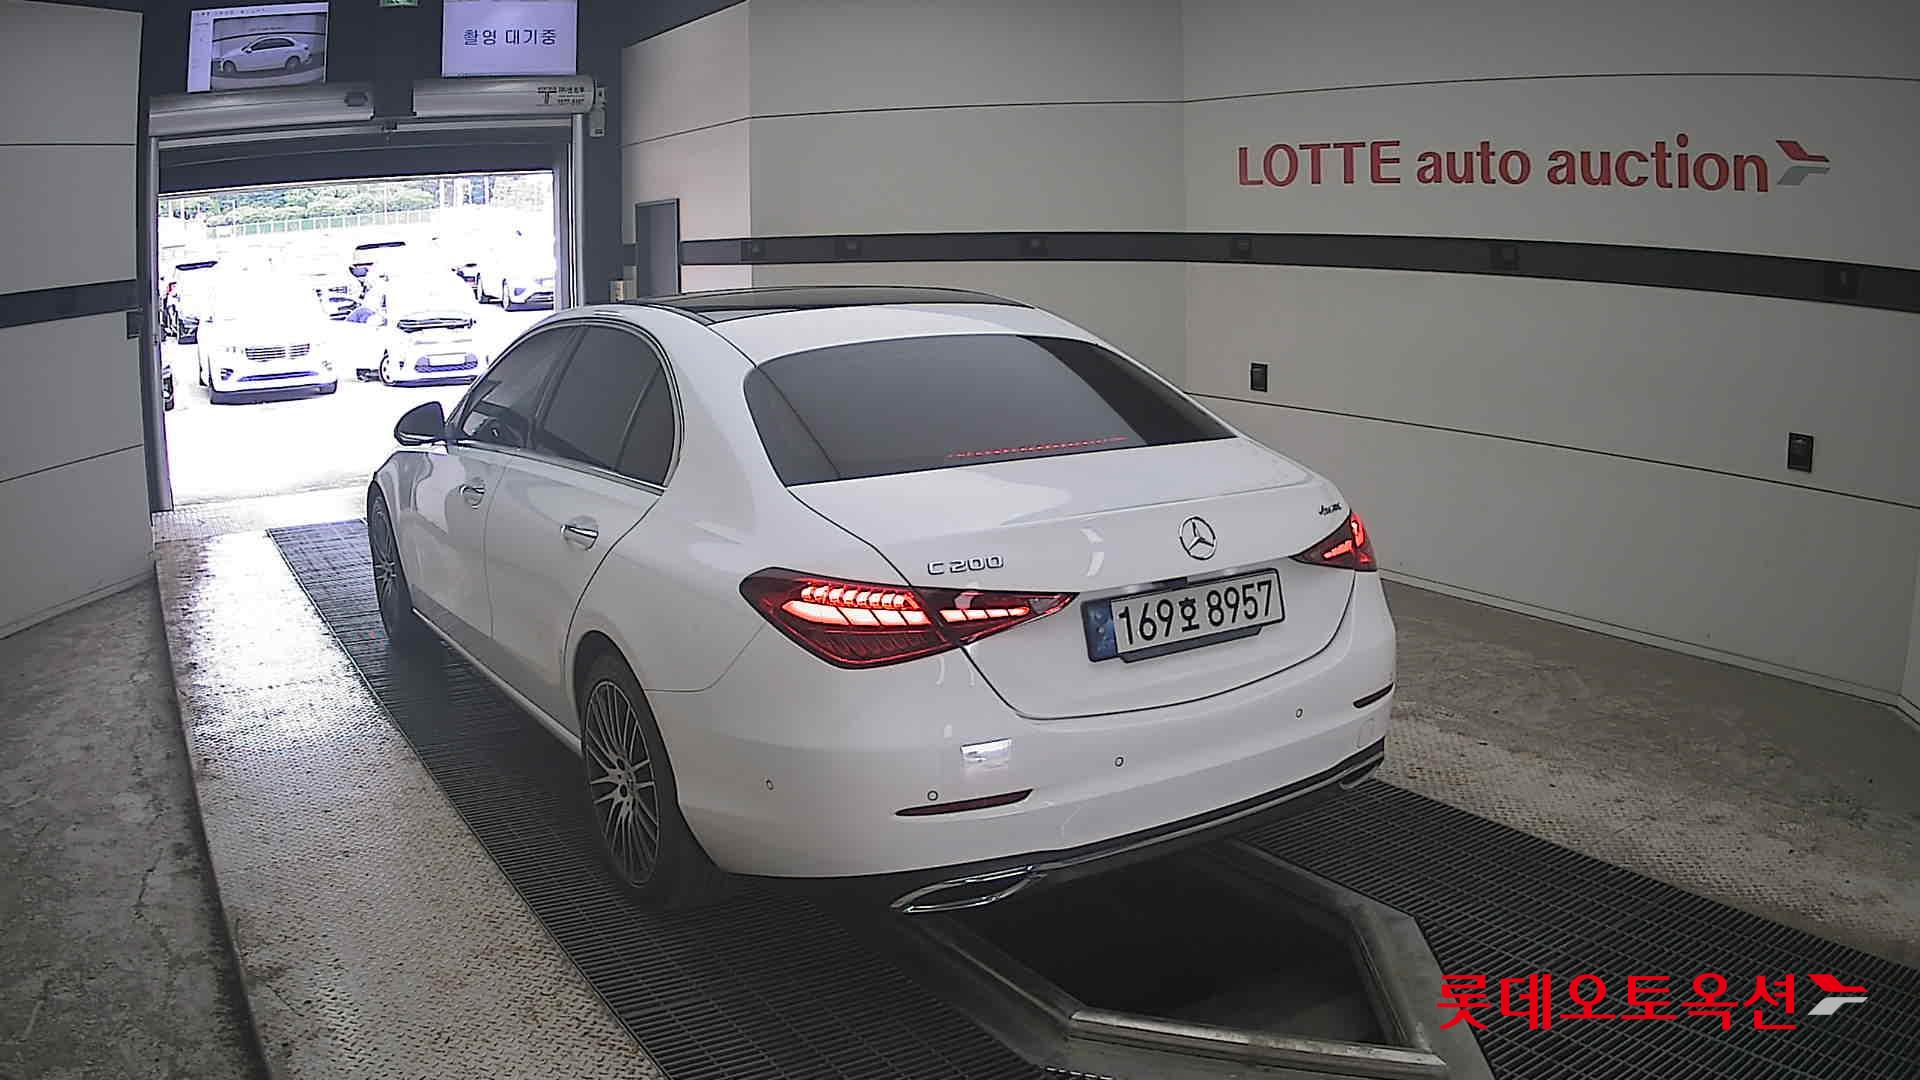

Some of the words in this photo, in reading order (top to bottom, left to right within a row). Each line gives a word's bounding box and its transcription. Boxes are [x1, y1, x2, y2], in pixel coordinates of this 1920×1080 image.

[505, 28, 557, 46] 대기중
[1238, 140, 1400, 187] LOTTE
[1416, 140, 1532, 185] auto
[1547, 133, 1769, 192] auction
[928, 560, 945, 576] C
[950, 555, 1004, 573] 200
[1118, 597, 1200, 645] 169호
[1207, 579, 1272, 627] 8957
